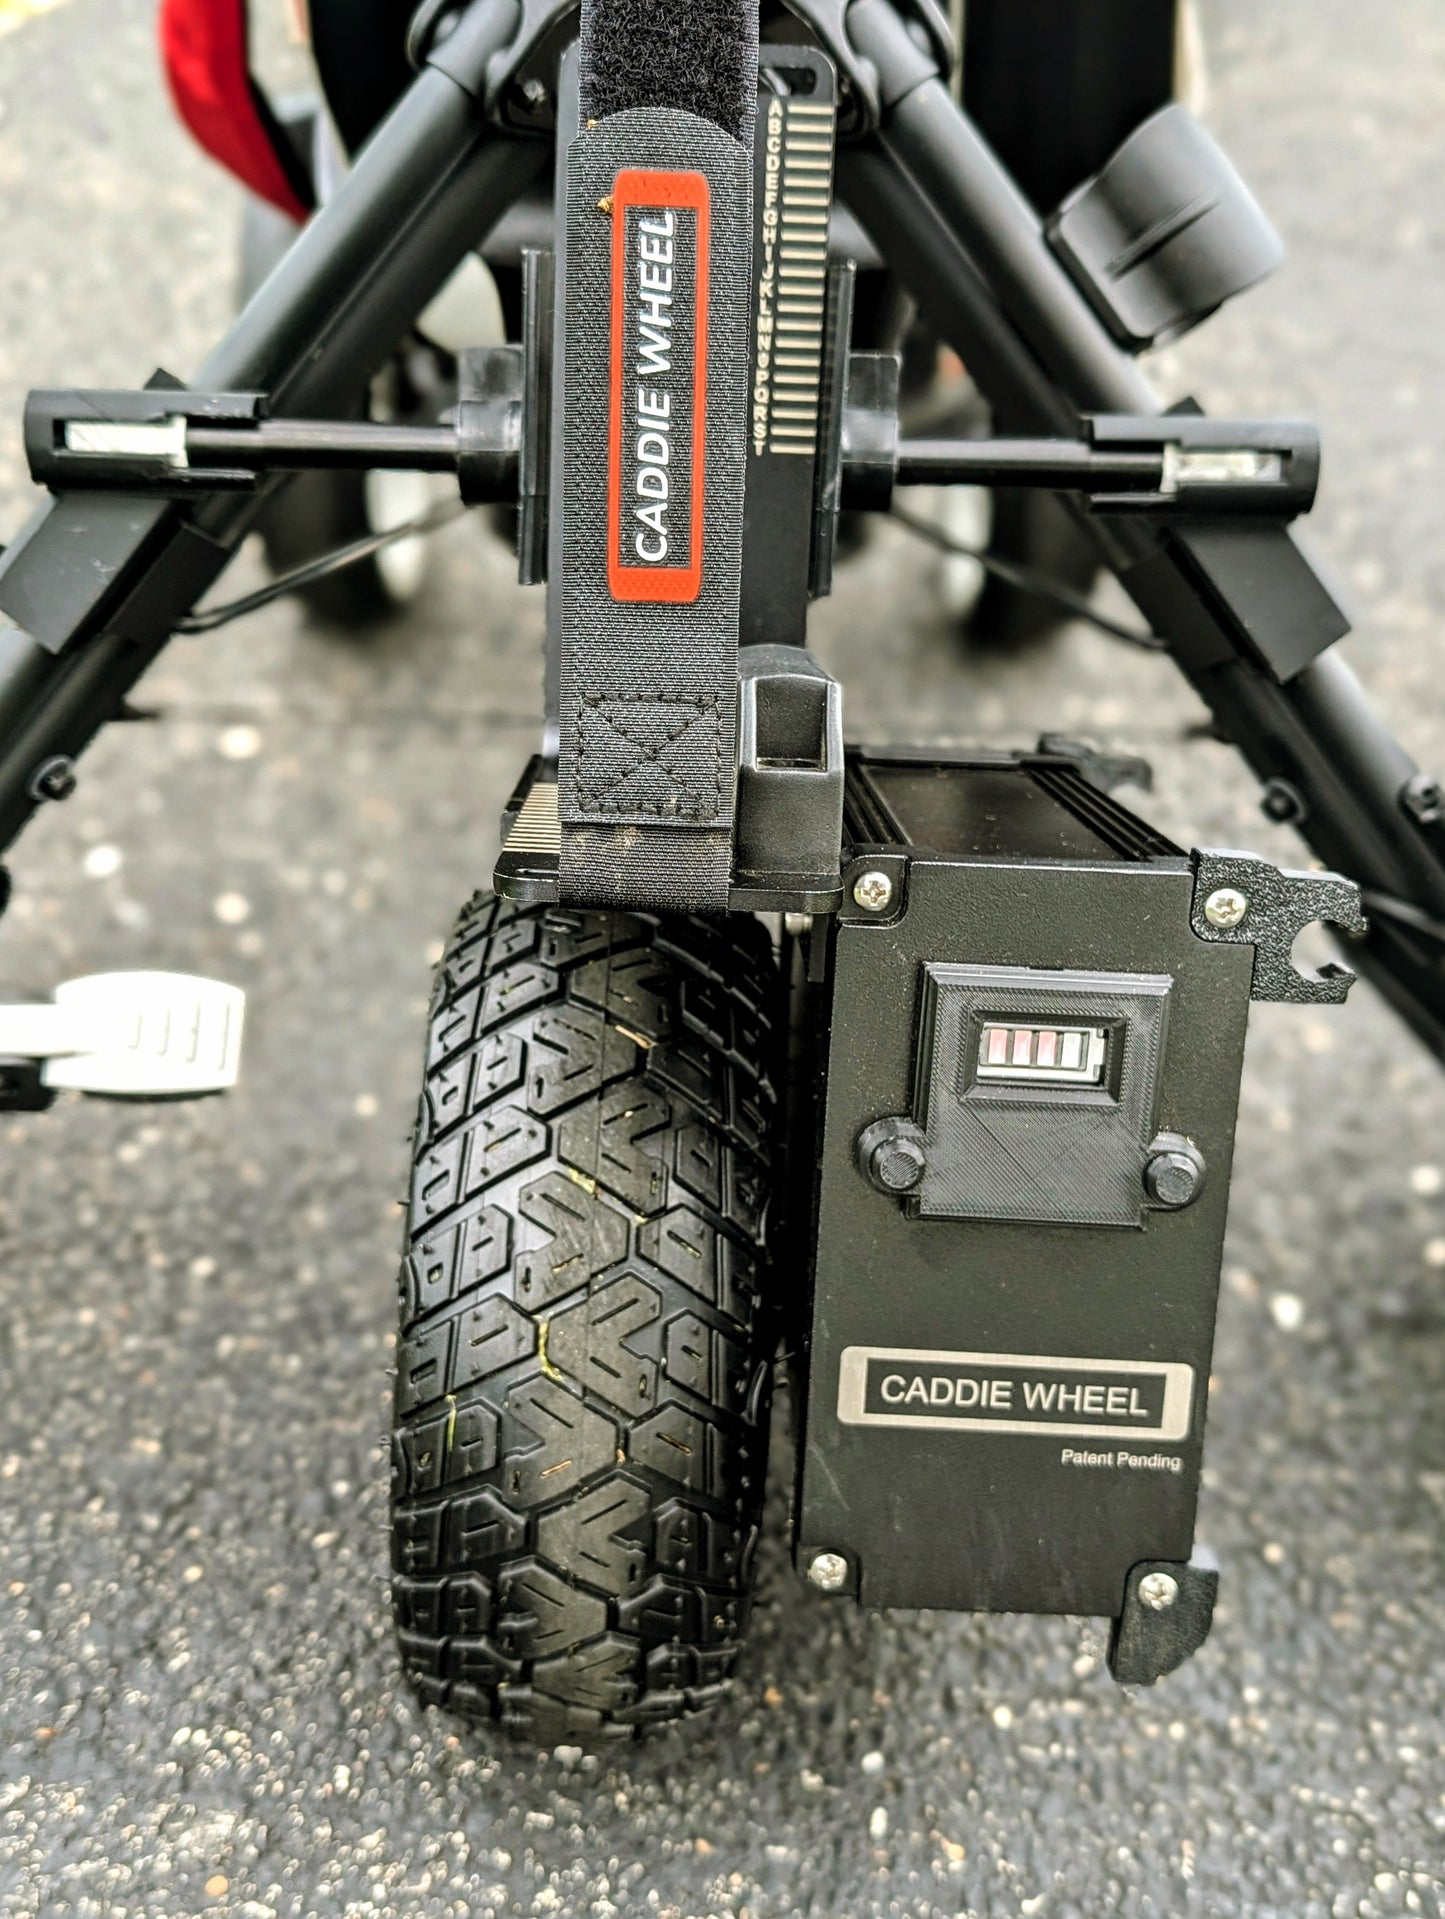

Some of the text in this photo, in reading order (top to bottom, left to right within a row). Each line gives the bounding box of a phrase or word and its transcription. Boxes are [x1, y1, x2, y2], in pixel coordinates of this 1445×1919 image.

[635, 208, 674, 562] CADDIE WHEEL
[880, 1374, 1149, 1416] CADDIE WHEEL
[1061, 1448, 1183, 1474] Patent Pending
